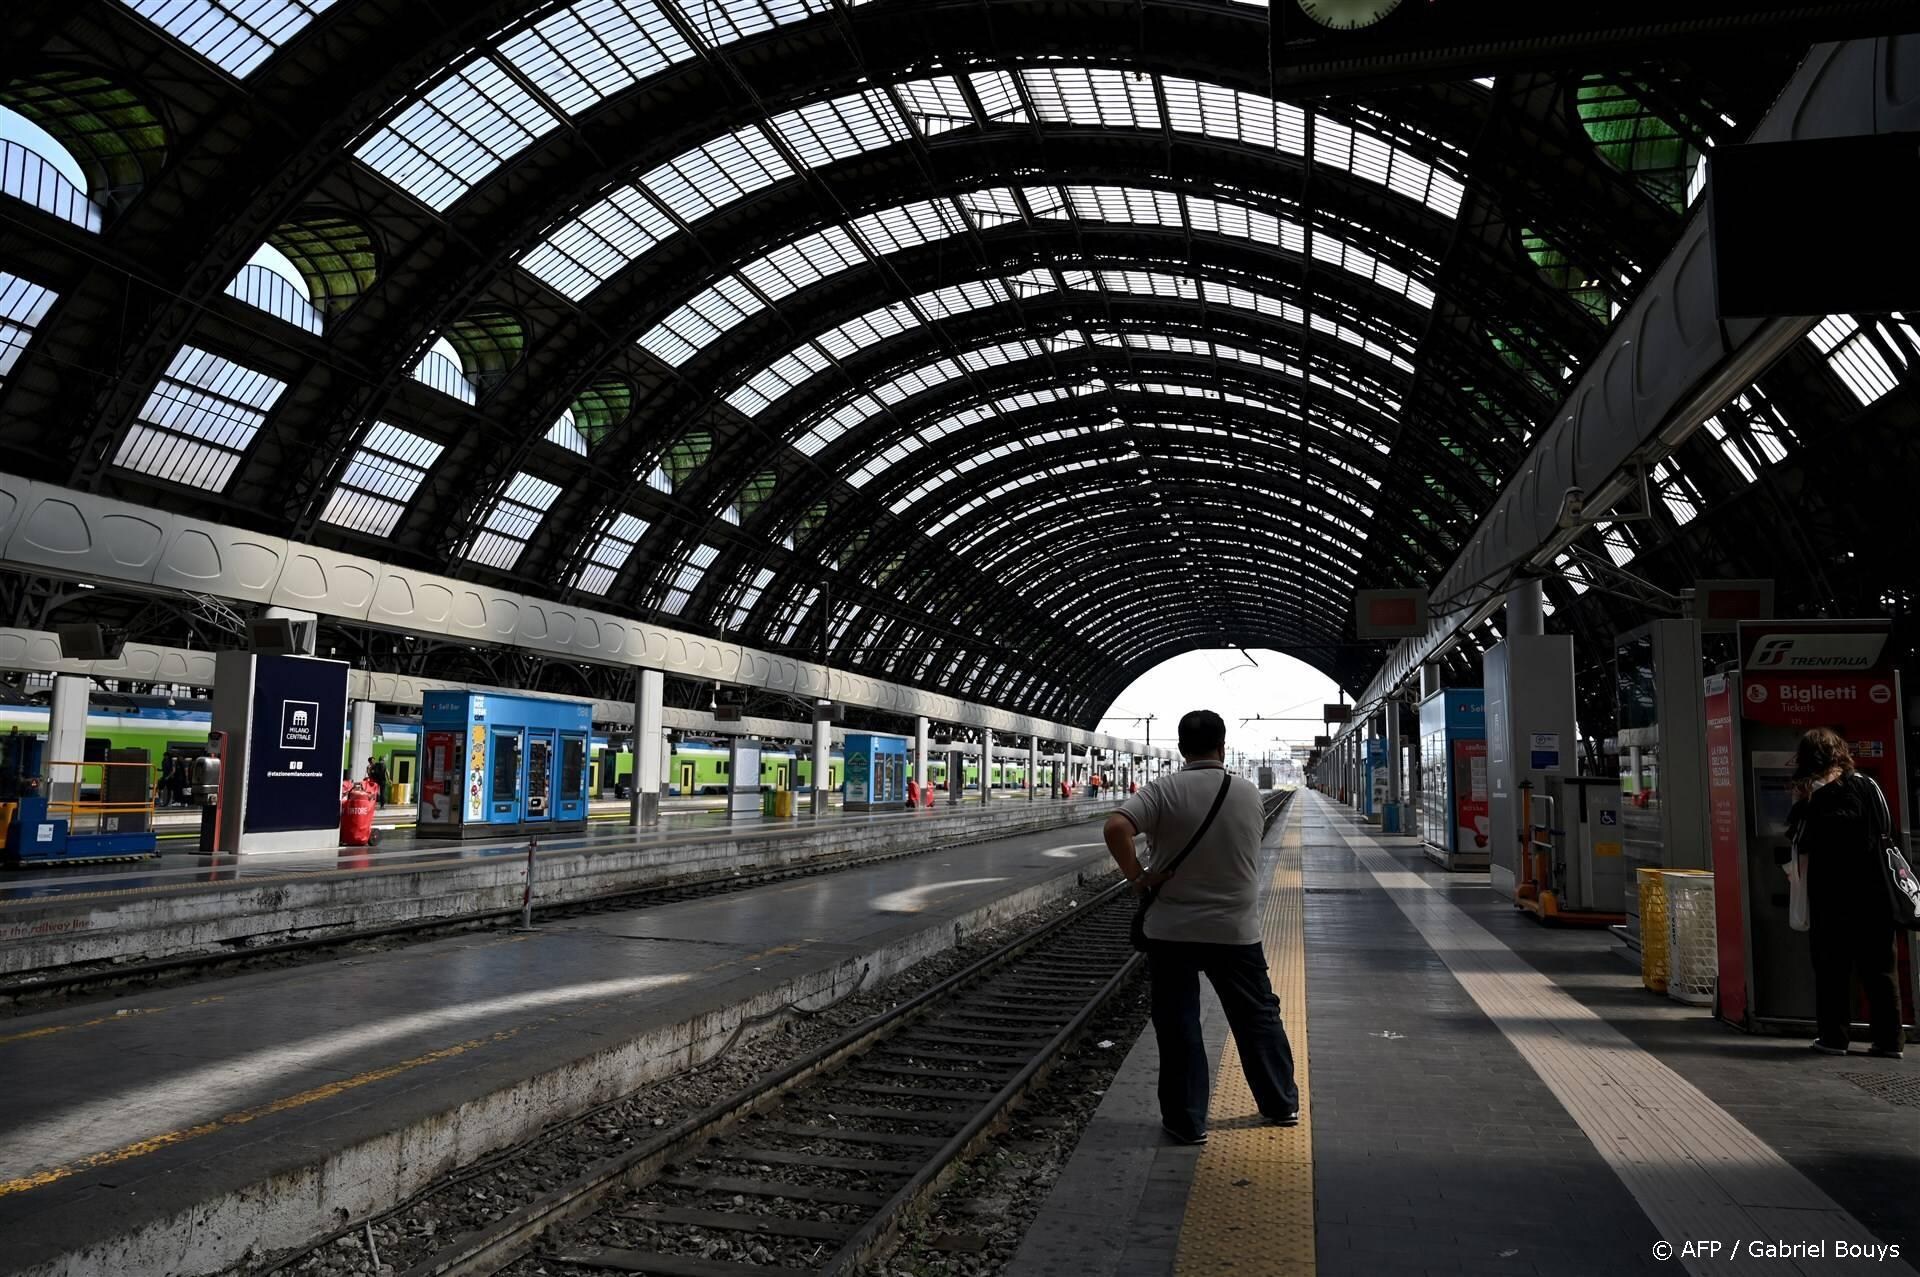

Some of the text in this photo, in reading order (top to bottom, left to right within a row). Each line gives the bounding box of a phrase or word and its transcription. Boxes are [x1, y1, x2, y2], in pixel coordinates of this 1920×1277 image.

[1790, 656, 1868, 666] TRENITALIA
[1780, 684, 1857, 703] Biglietti
[1781, 702, 1815, 713] Tickets
[286, 733, 312, 741] CENTRALE
[31, 920, 71, 934] railway
